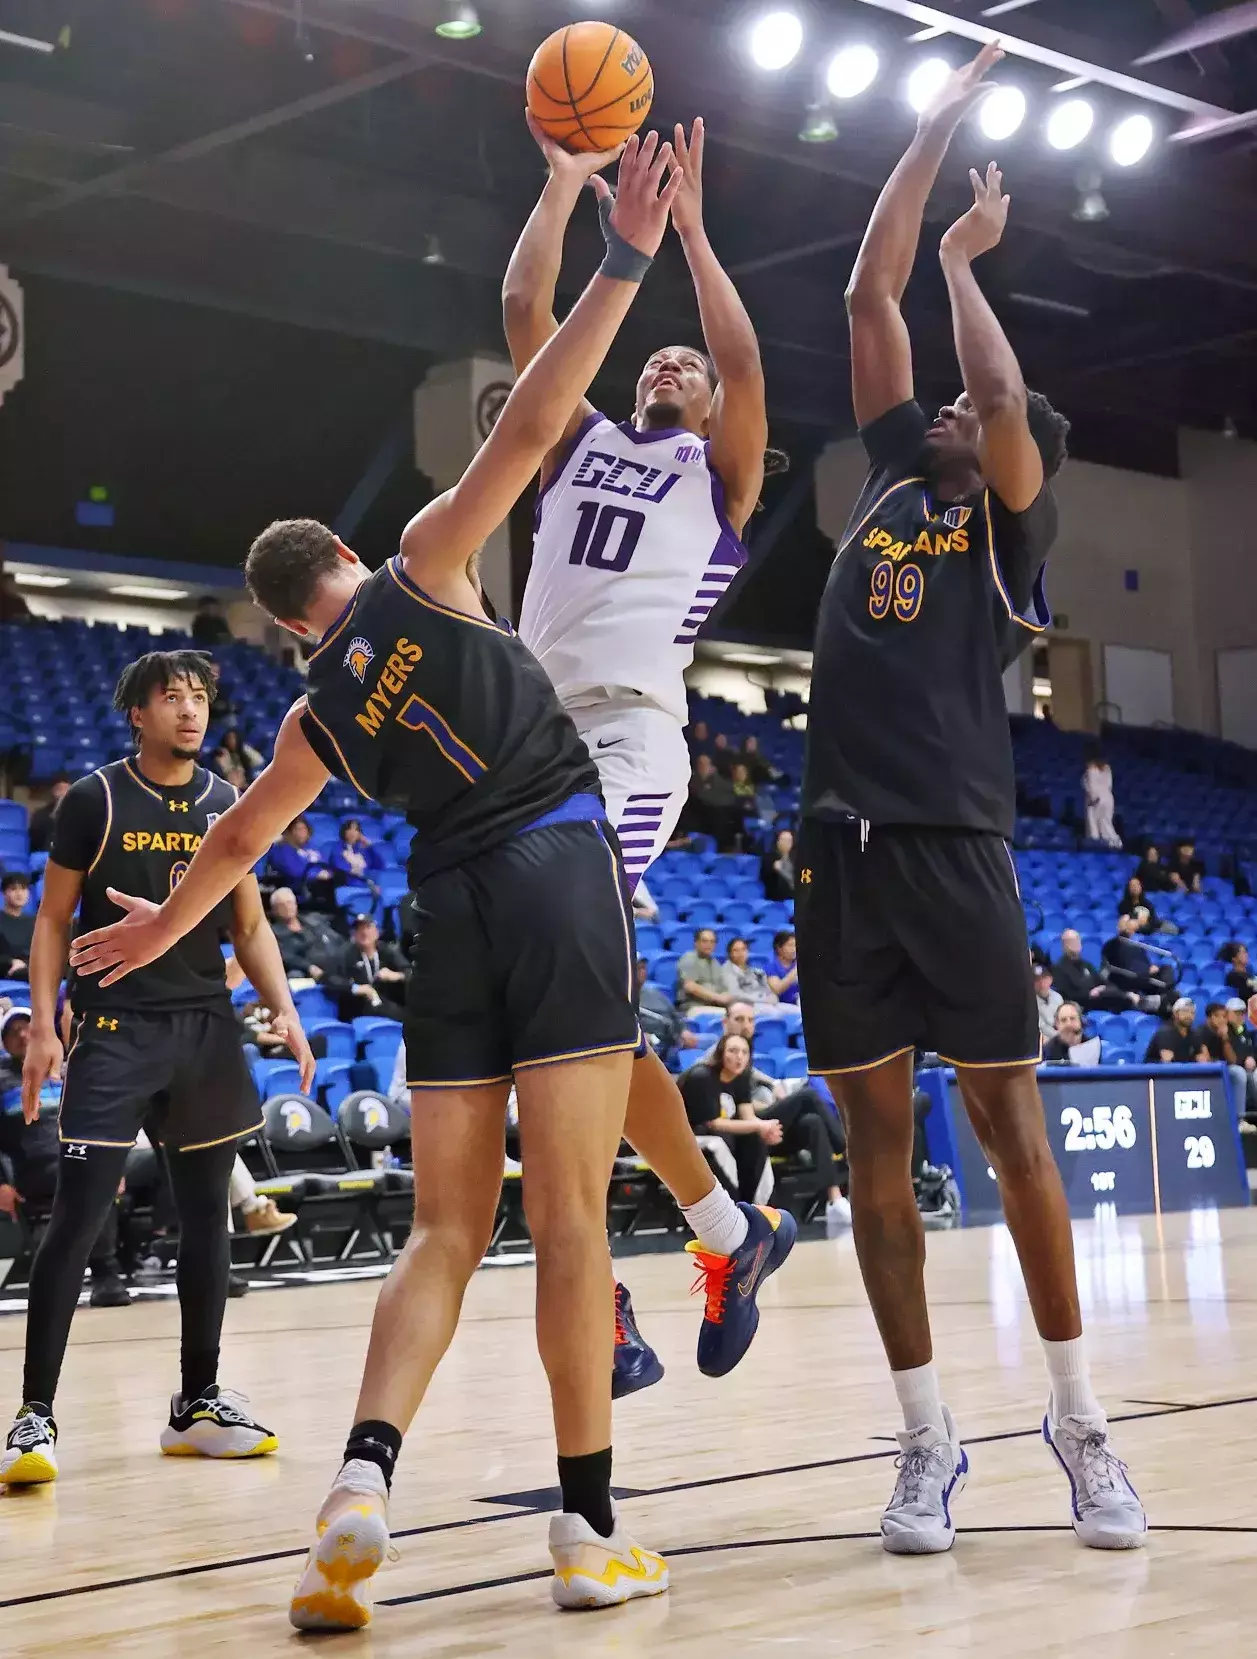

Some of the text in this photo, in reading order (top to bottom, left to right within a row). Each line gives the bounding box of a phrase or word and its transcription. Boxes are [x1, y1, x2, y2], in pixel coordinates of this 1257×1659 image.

[572, 450, 682, 503] GCU
[569, 501, 646, 572] 10
[869, 560, 924, 622] 99
[355, 638, 423, 737] MYERS
[395, 693, 489, 784] 7
[122, 831, 204, 853] SPARTA
[1060, 1105, 1136, 1152] 2:56
[1184, 1135, 1216, 1168] 29
